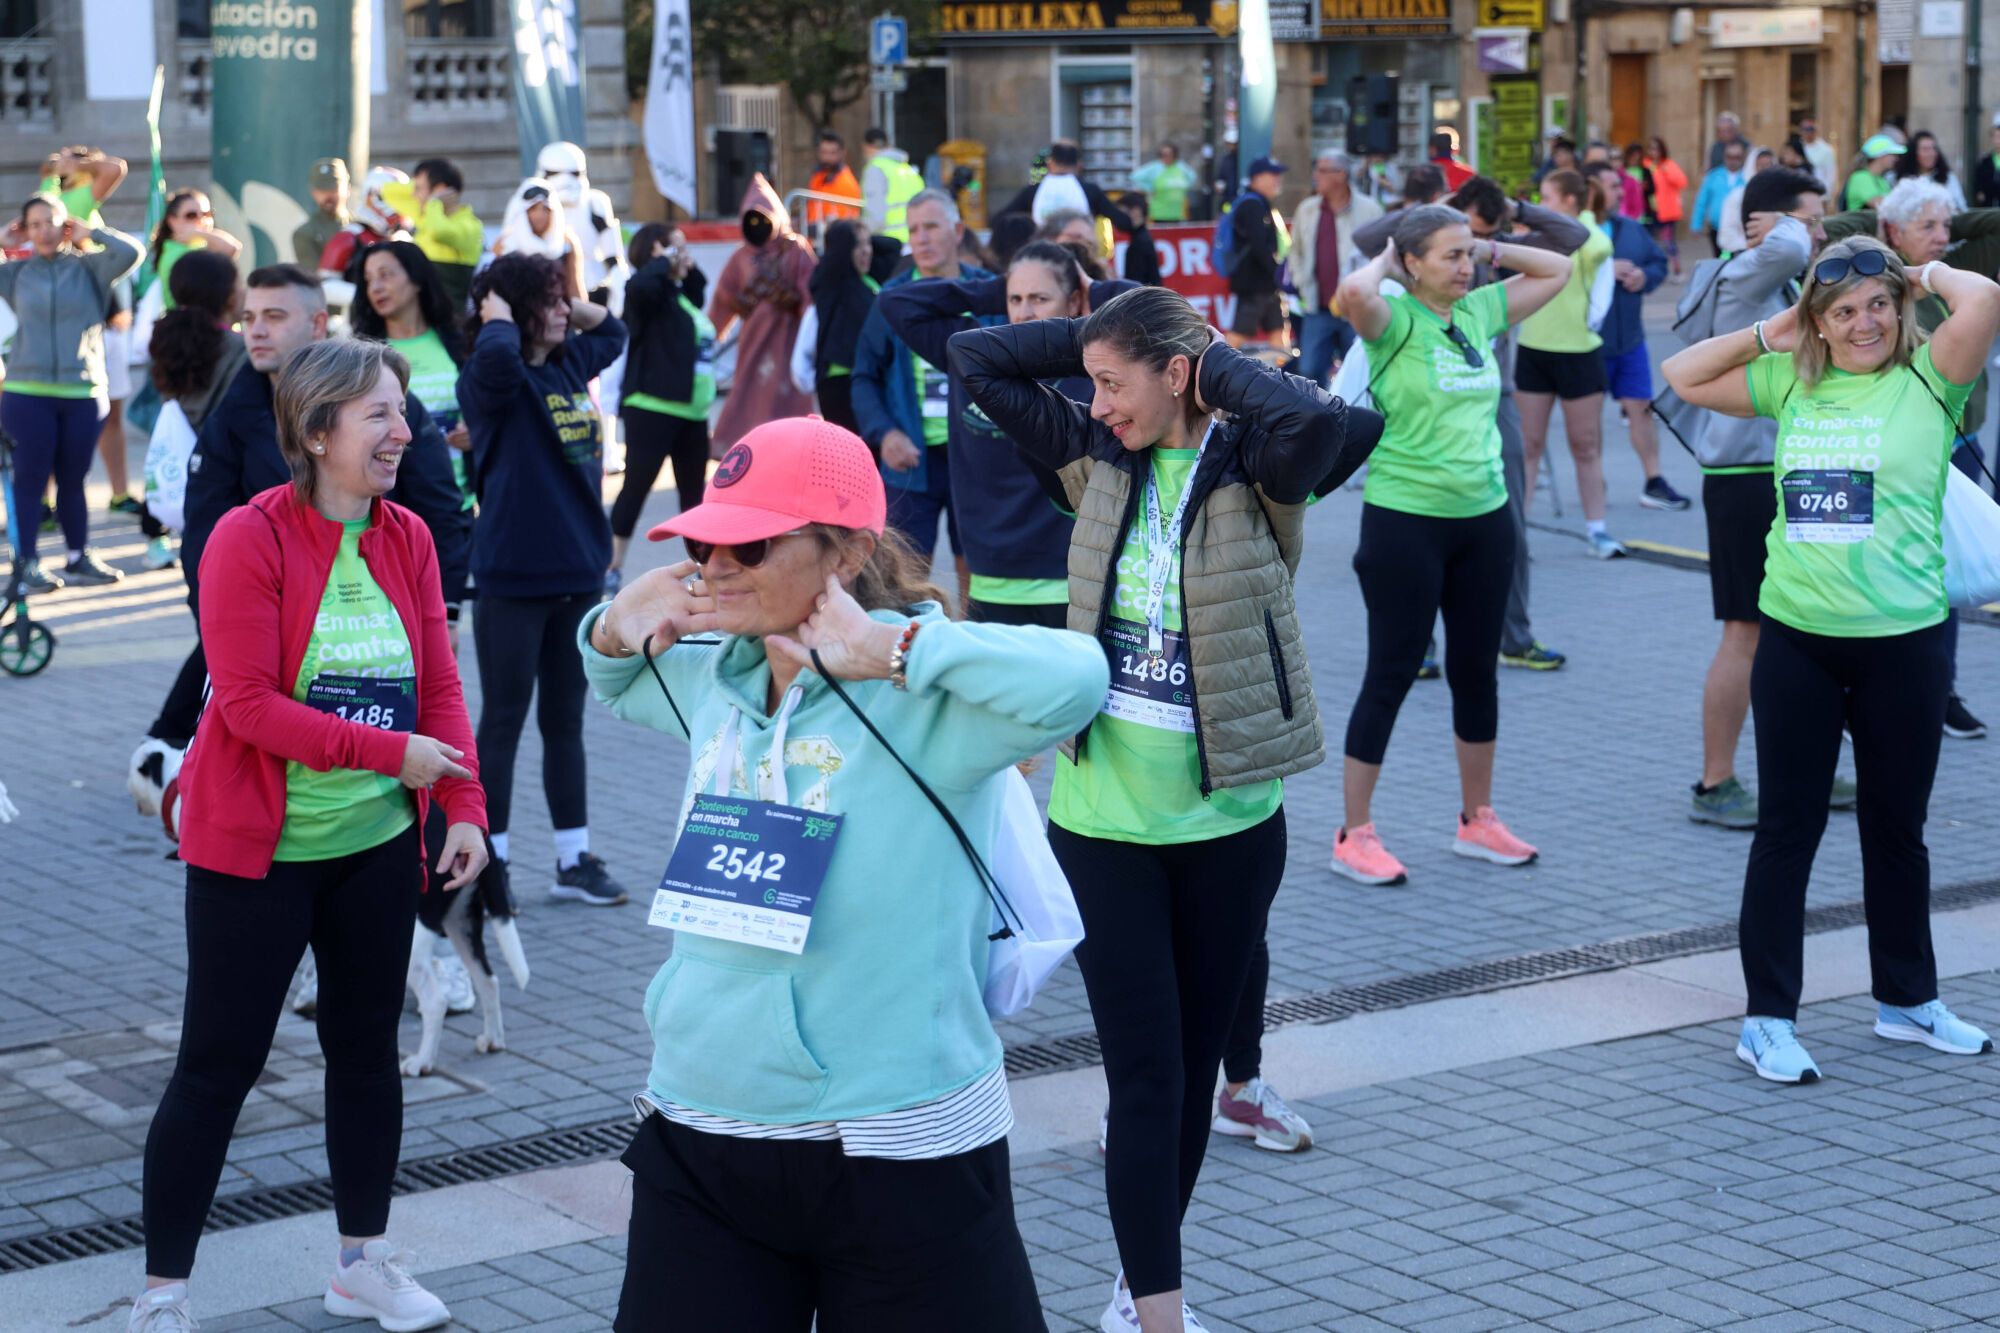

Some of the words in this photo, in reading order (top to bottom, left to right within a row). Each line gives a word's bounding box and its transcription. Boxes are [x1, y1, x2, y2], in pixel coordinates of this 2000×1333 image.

[879, 24, 899, 59] P
[1784, 433, 1859, 449] contra
[1781, 452, 1881, 471] cancro
[1799, 492, 1848, 512] 0746
[1113, 630, 1142, 644] marcha
[319, 635, 406, 662] contra
[1121, 654, 1187, 686] 1486
[324, 686, 356, 696] marcha
[335, 705, 394, 730] 1485
[696, 800, 749, 816] Pontevedra
[691, 812, 704, 822] en
[704, 813, 740, 827] marcha
[687, 823, 716, 837] contra
[717, 829, 725, 837] o
[726, 828, 760, 842] cancro
[706, 843, 786, 882] 2542
